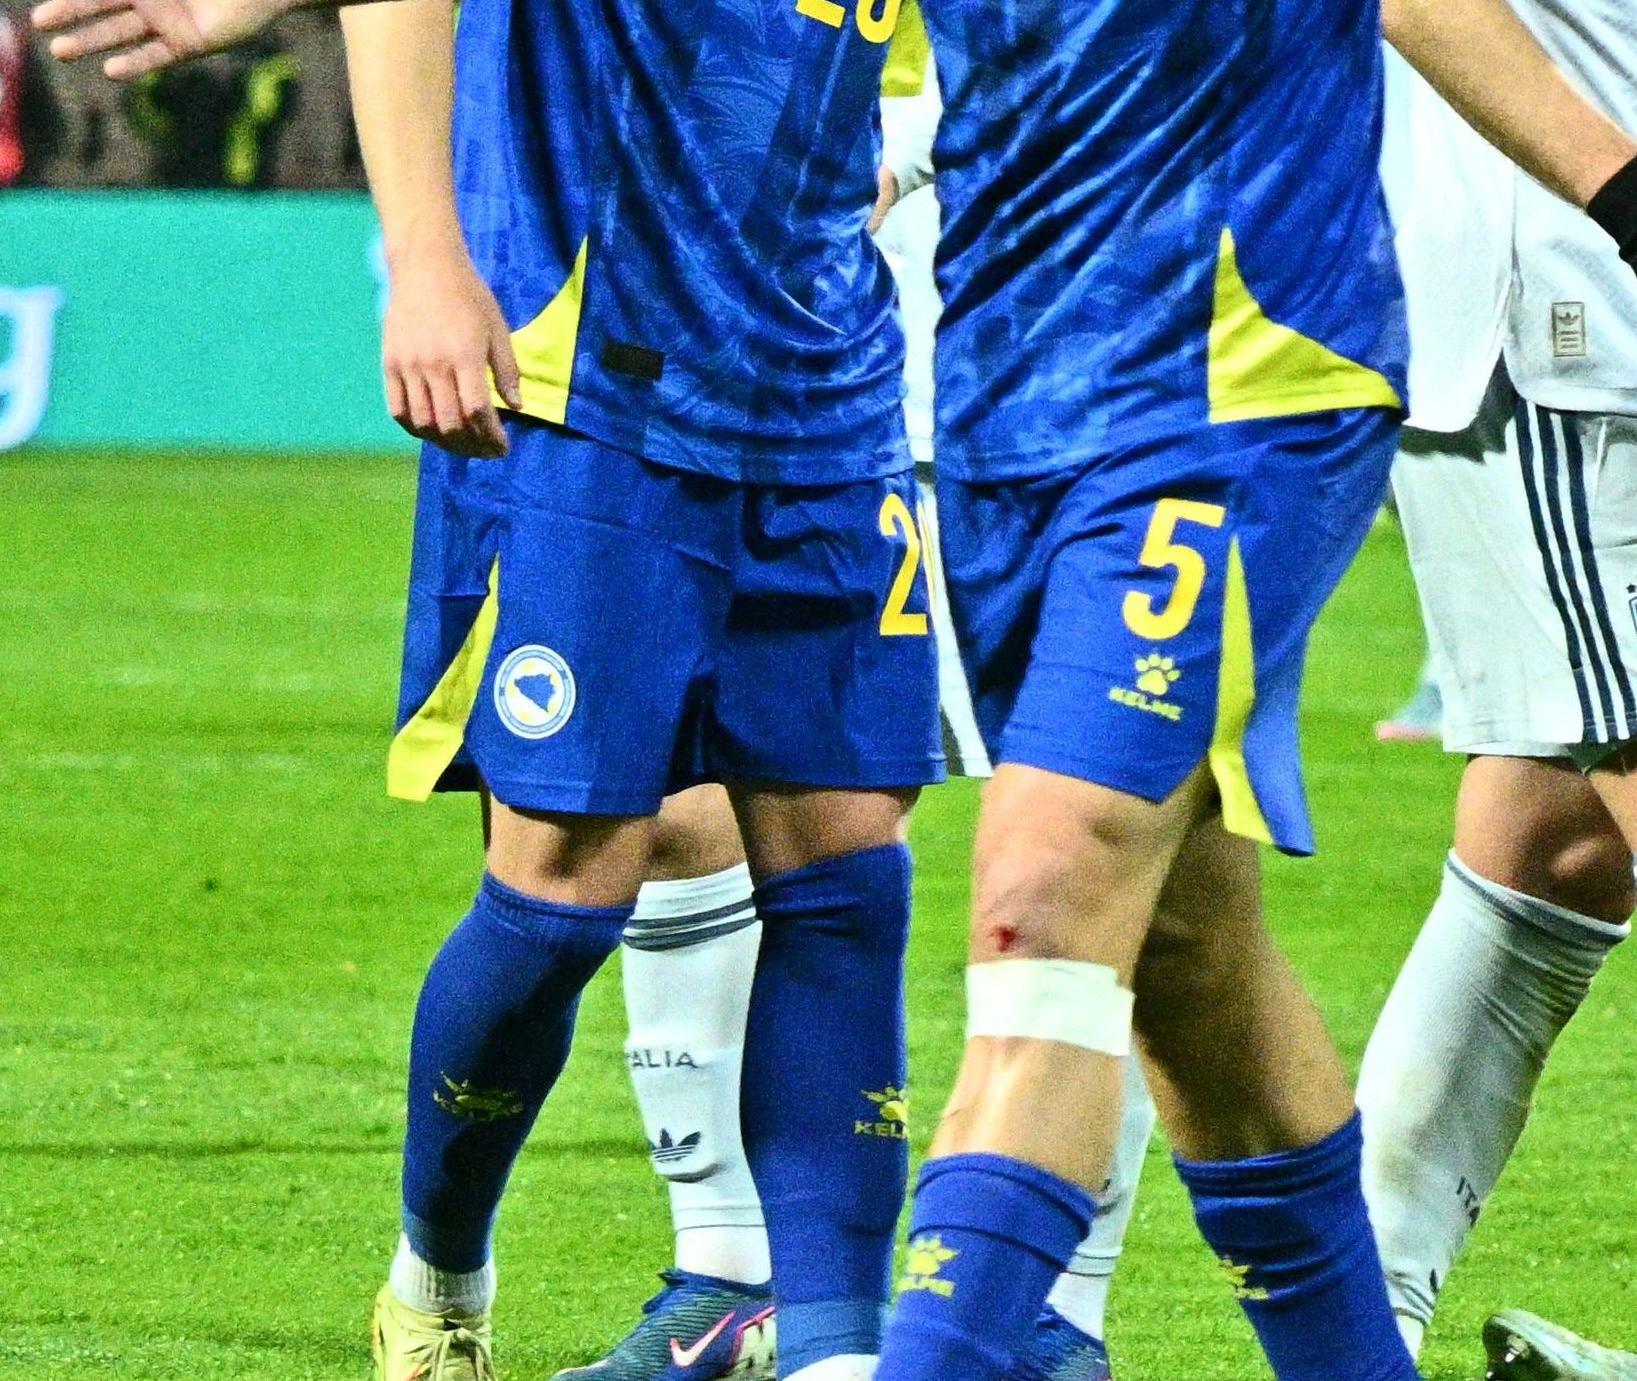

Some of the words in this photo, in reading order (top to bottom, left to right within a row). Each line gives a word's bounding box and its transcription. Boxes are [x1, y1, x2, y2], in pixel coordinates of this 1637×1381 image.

[879, 492, 937, 636] 2
[1122, 497, 1227, 640] 5
[627, 1048, 699, 1069] ALIA
